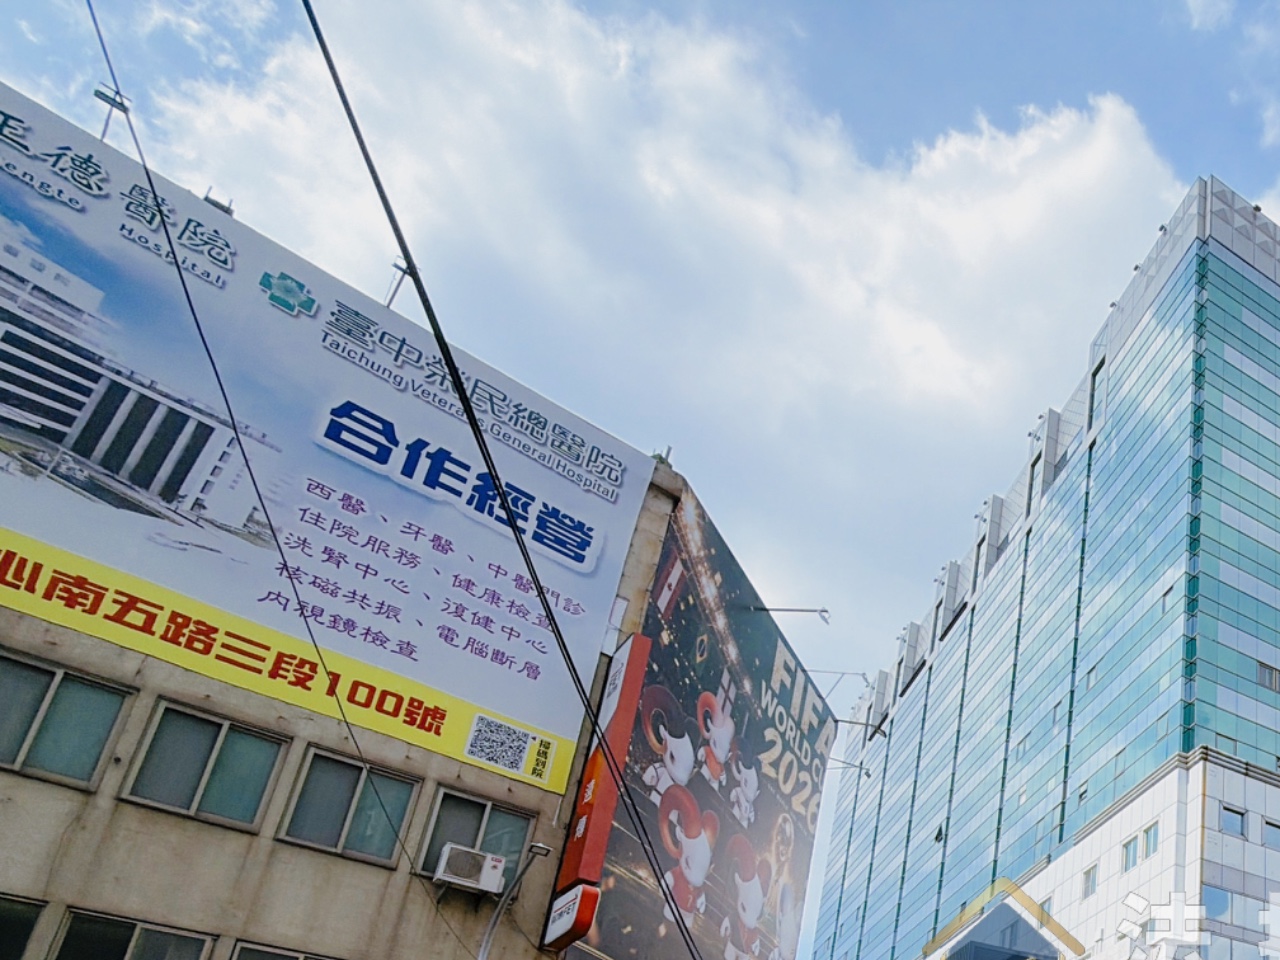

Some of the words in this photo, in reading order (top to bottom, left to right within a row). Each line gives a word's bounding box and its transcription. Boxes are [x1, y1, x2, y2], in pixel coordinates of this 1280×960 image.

[118, 222, 224, 286] Hospital
[320, 330, 405, 389] Taichung
[409, 379, 485, 430] Veteras
[490, 422, 552, 468] General
[555, 457, 618, 501] Hospital
[324, 299, 626, 485] 臺中榮民總醫院
[323, 399, 595, 565] 合作經營
[298, 506, 555, 634] 住院服務、健康檢查
[306, 477, 586, 617] 西醫、牙醫、中醫門診
[0, 547, 448, 738] 心南五路三段100號
[257, 590, 420, 663] 內視鏡檢查
[274, 560, 542, 682] 核磁共振、電腦斷層
[760, 678, 811, 768] WORLD
[770, 637, 838, 760] FIFA
[758, 727, 821, 836] 2026
